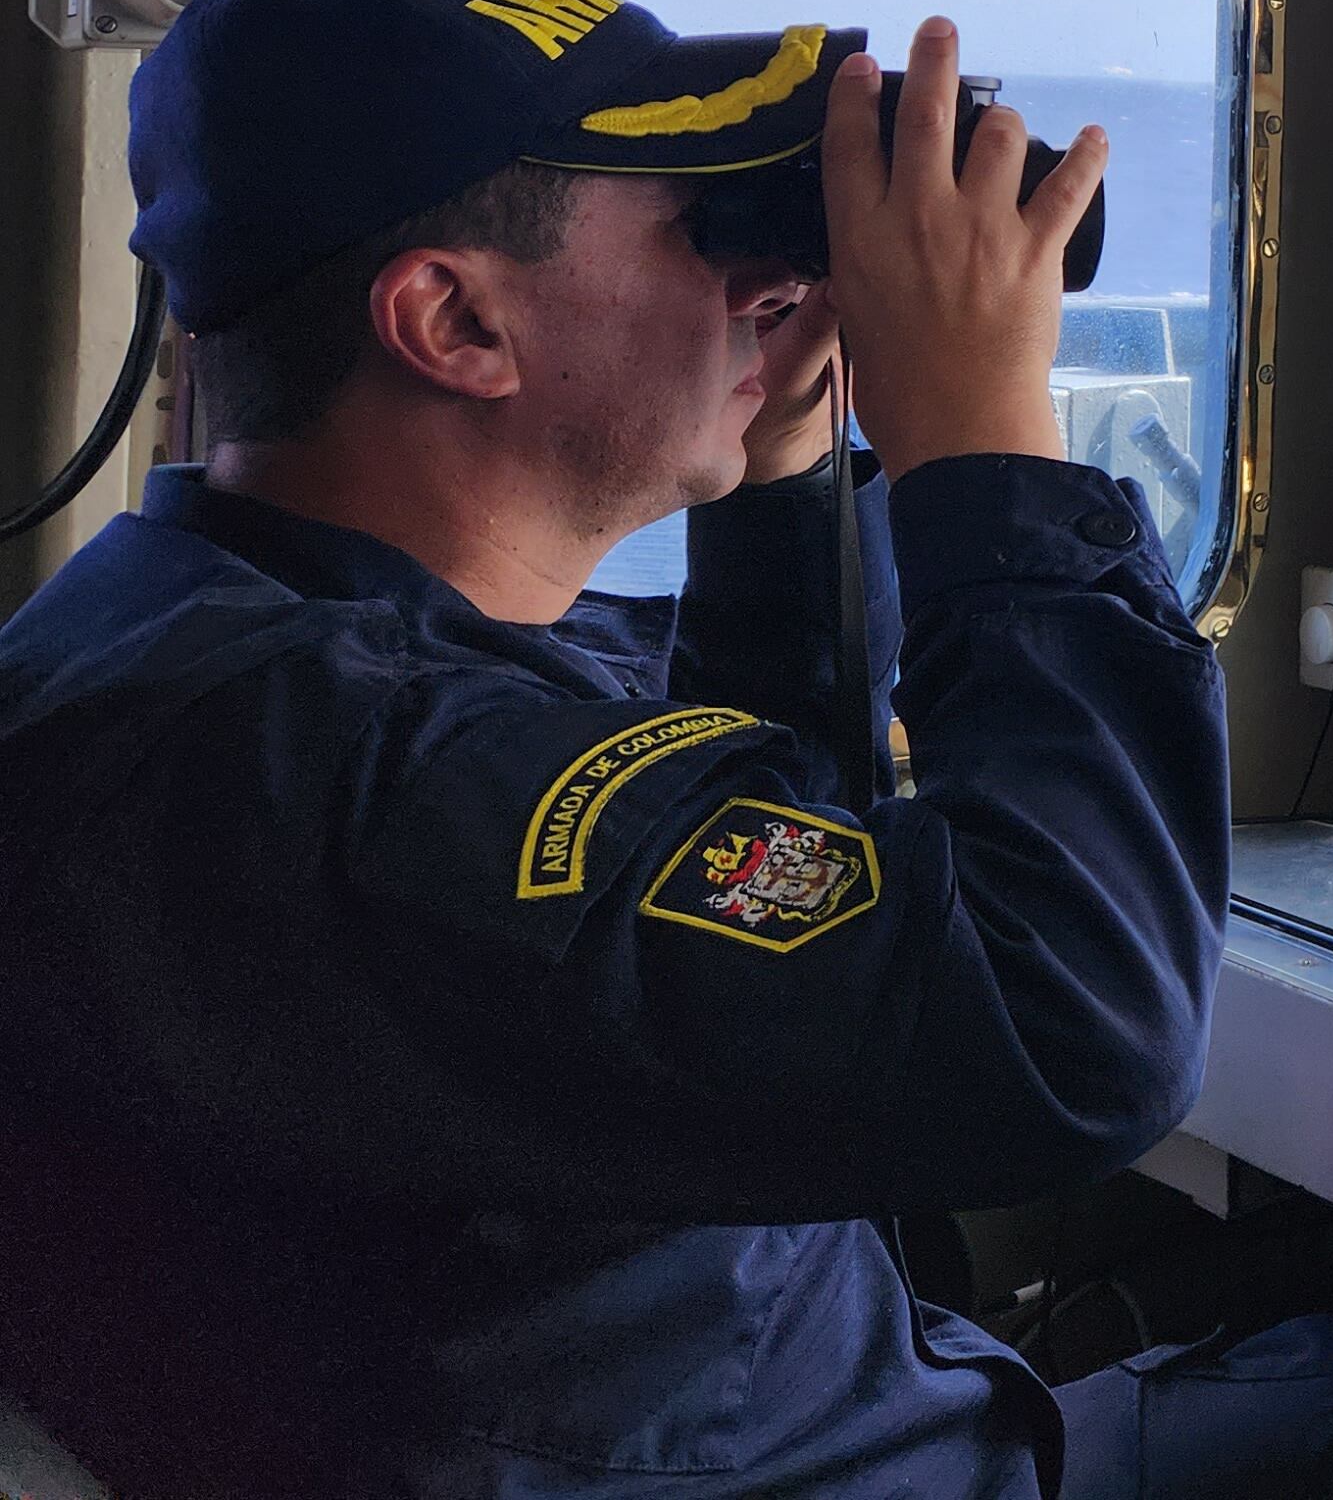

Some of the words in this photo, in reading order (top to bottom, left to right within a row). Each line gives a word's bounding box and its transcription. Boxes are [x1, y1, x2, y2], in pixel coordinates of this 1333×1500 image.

[541, 784, 597, 873] ARMADA
[586, 755, 623, 779] DE
[618, 713, 735, 757] COLOMBIA
